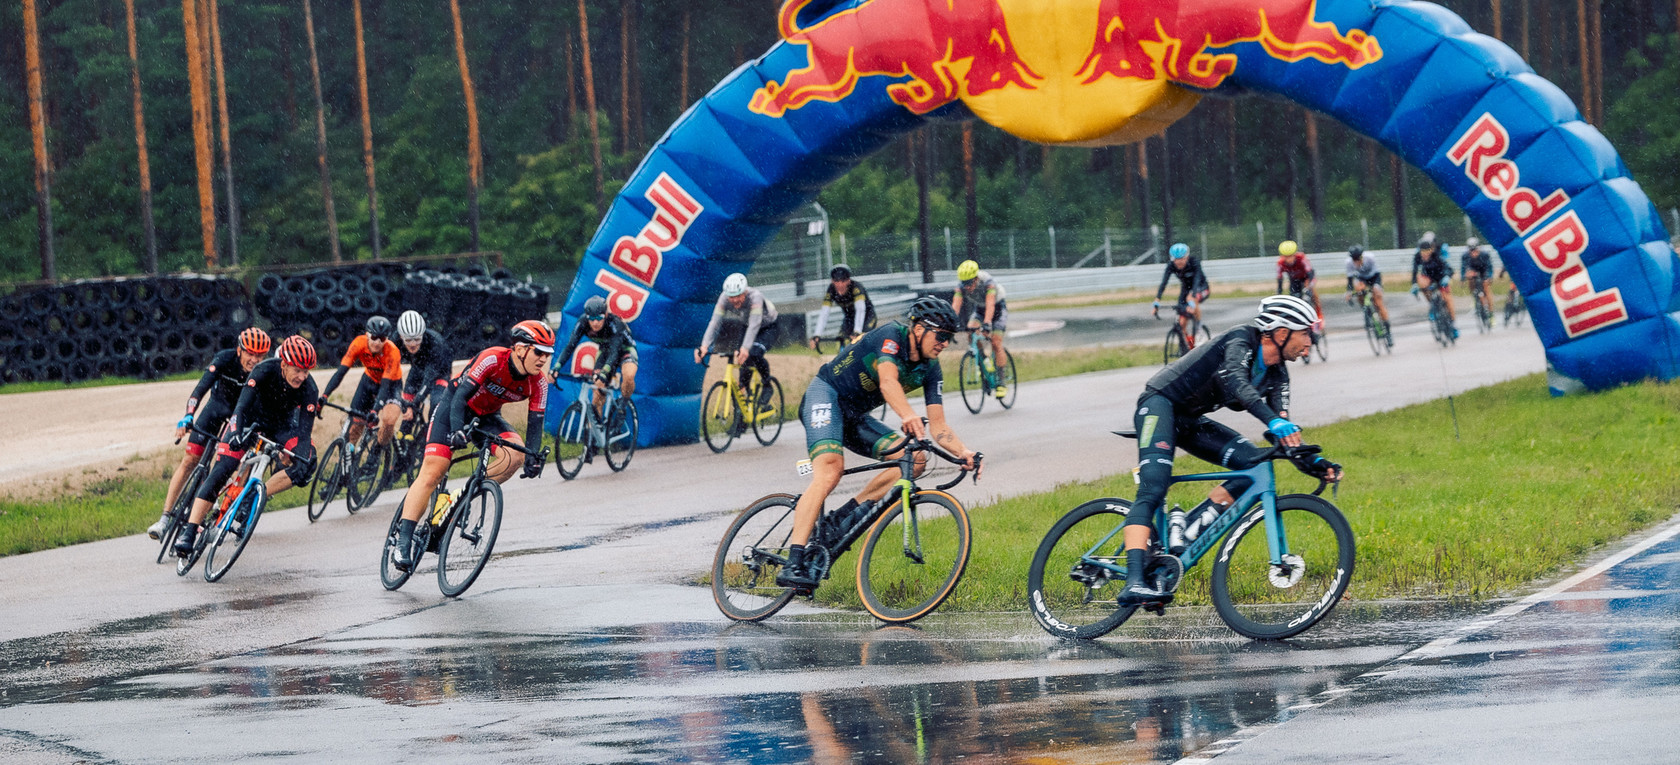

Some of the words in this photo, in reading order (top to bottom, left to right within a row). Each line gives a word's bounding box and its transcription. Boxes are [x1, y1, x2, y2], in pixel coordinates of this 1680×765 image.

[608, 171, 704, 288] Bull
[1446, 112, 1571, 237] Red
[1523, 209, 1629, 339] Bull
